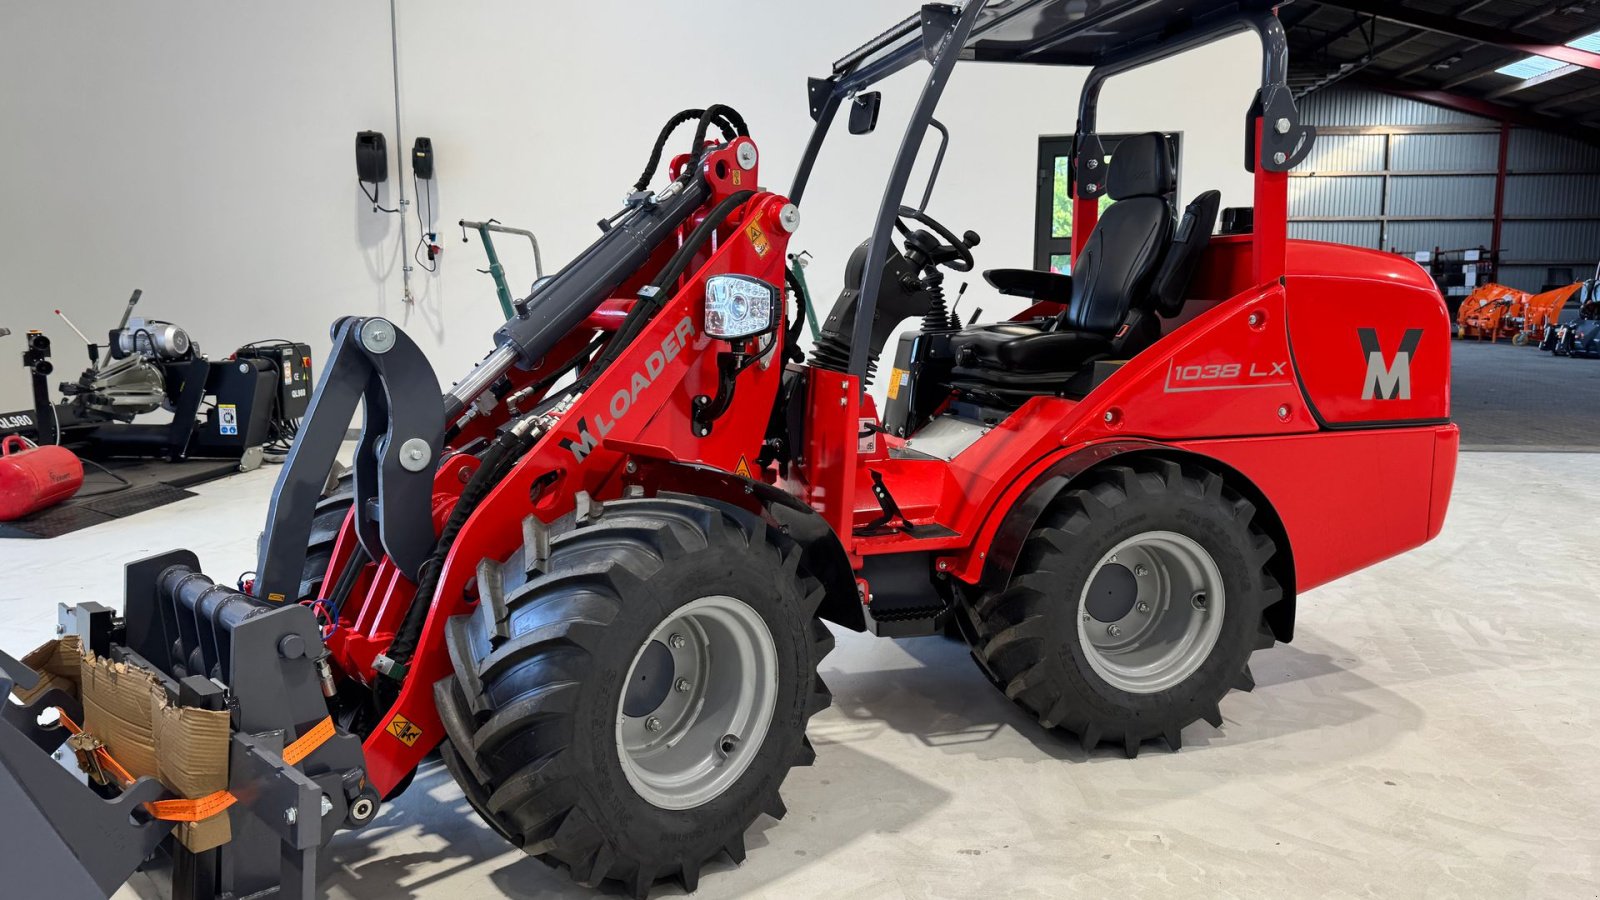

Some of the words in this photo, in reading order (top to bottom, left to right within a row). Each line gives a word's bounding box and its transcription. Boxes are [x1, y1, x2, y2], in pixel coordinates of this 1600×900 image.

[594, 316, 695, 438] LOADER
[1176, 364, 1241, 380] 1038
[1249, 361, 1287, 377] LX
